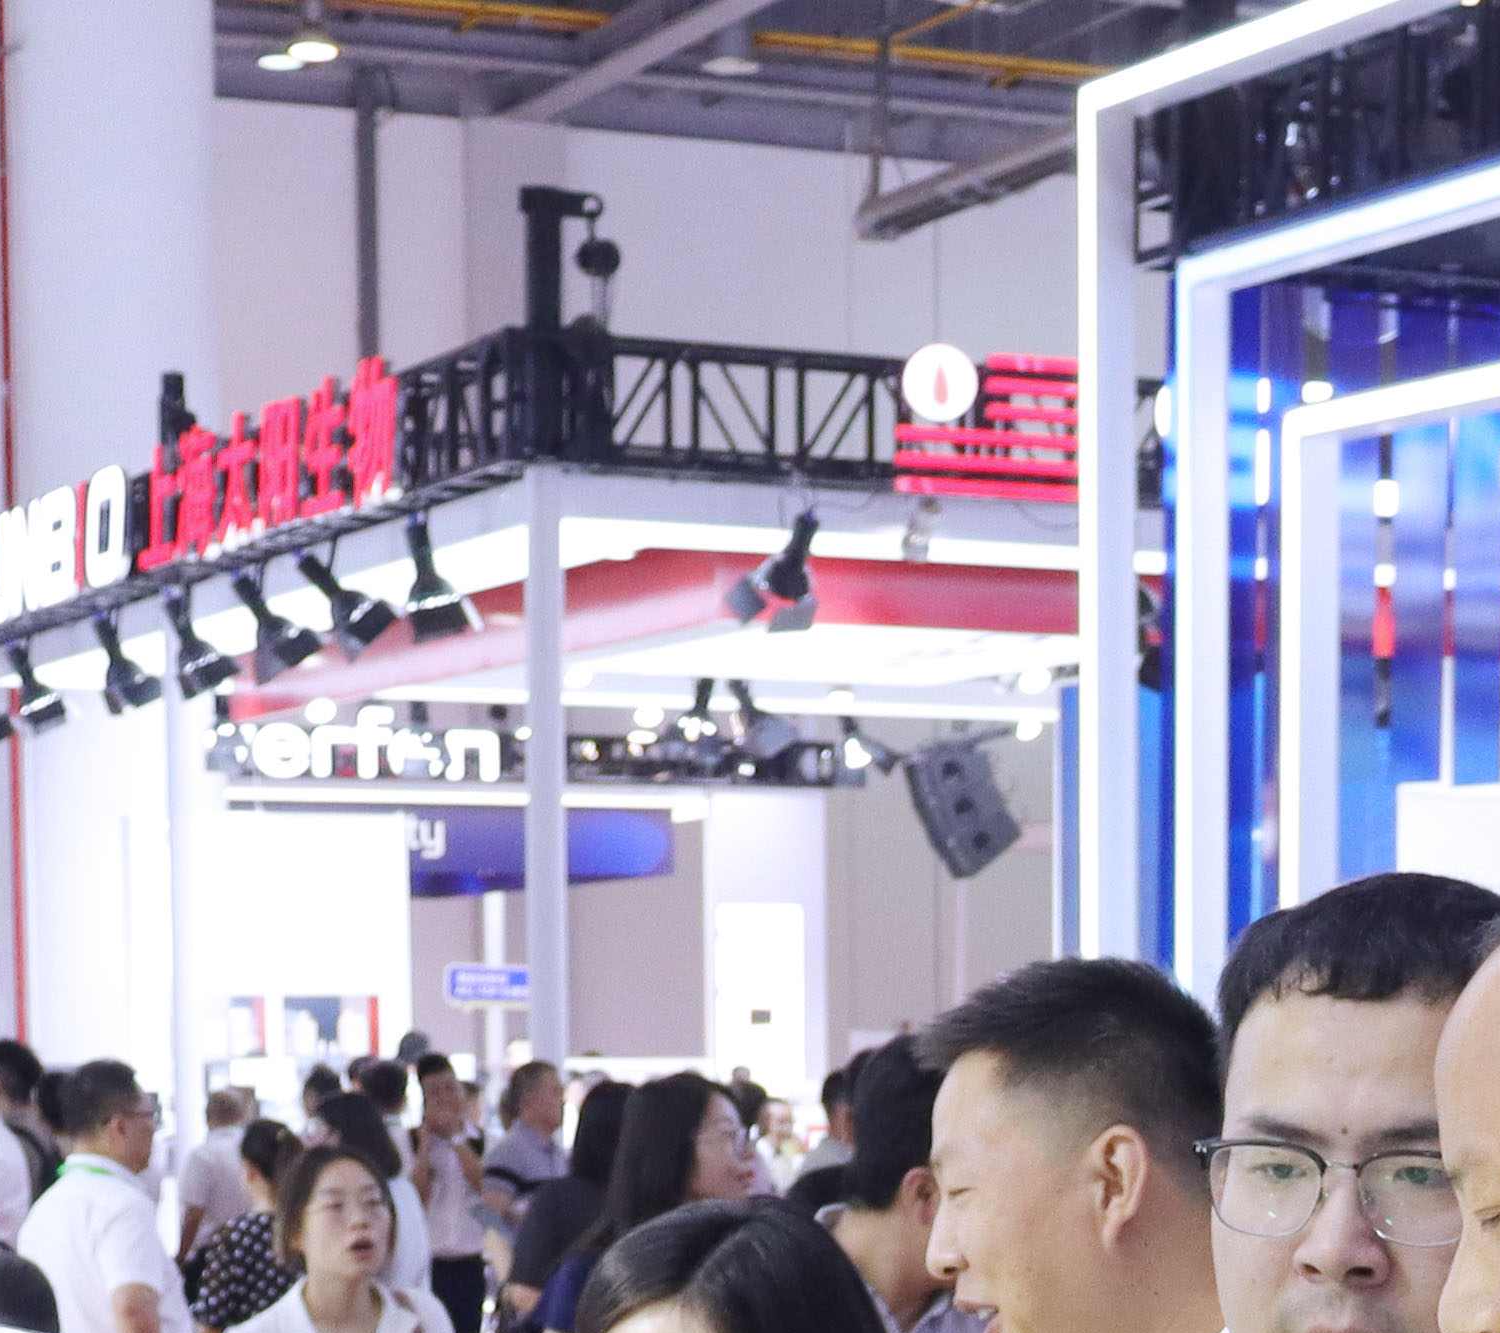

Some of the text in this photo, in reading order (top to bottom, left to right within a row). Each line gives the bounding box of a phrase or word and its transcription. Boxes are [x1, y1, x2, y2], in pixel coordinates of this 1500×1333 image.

[137, 356, 397, 571] 上海太阳生物
